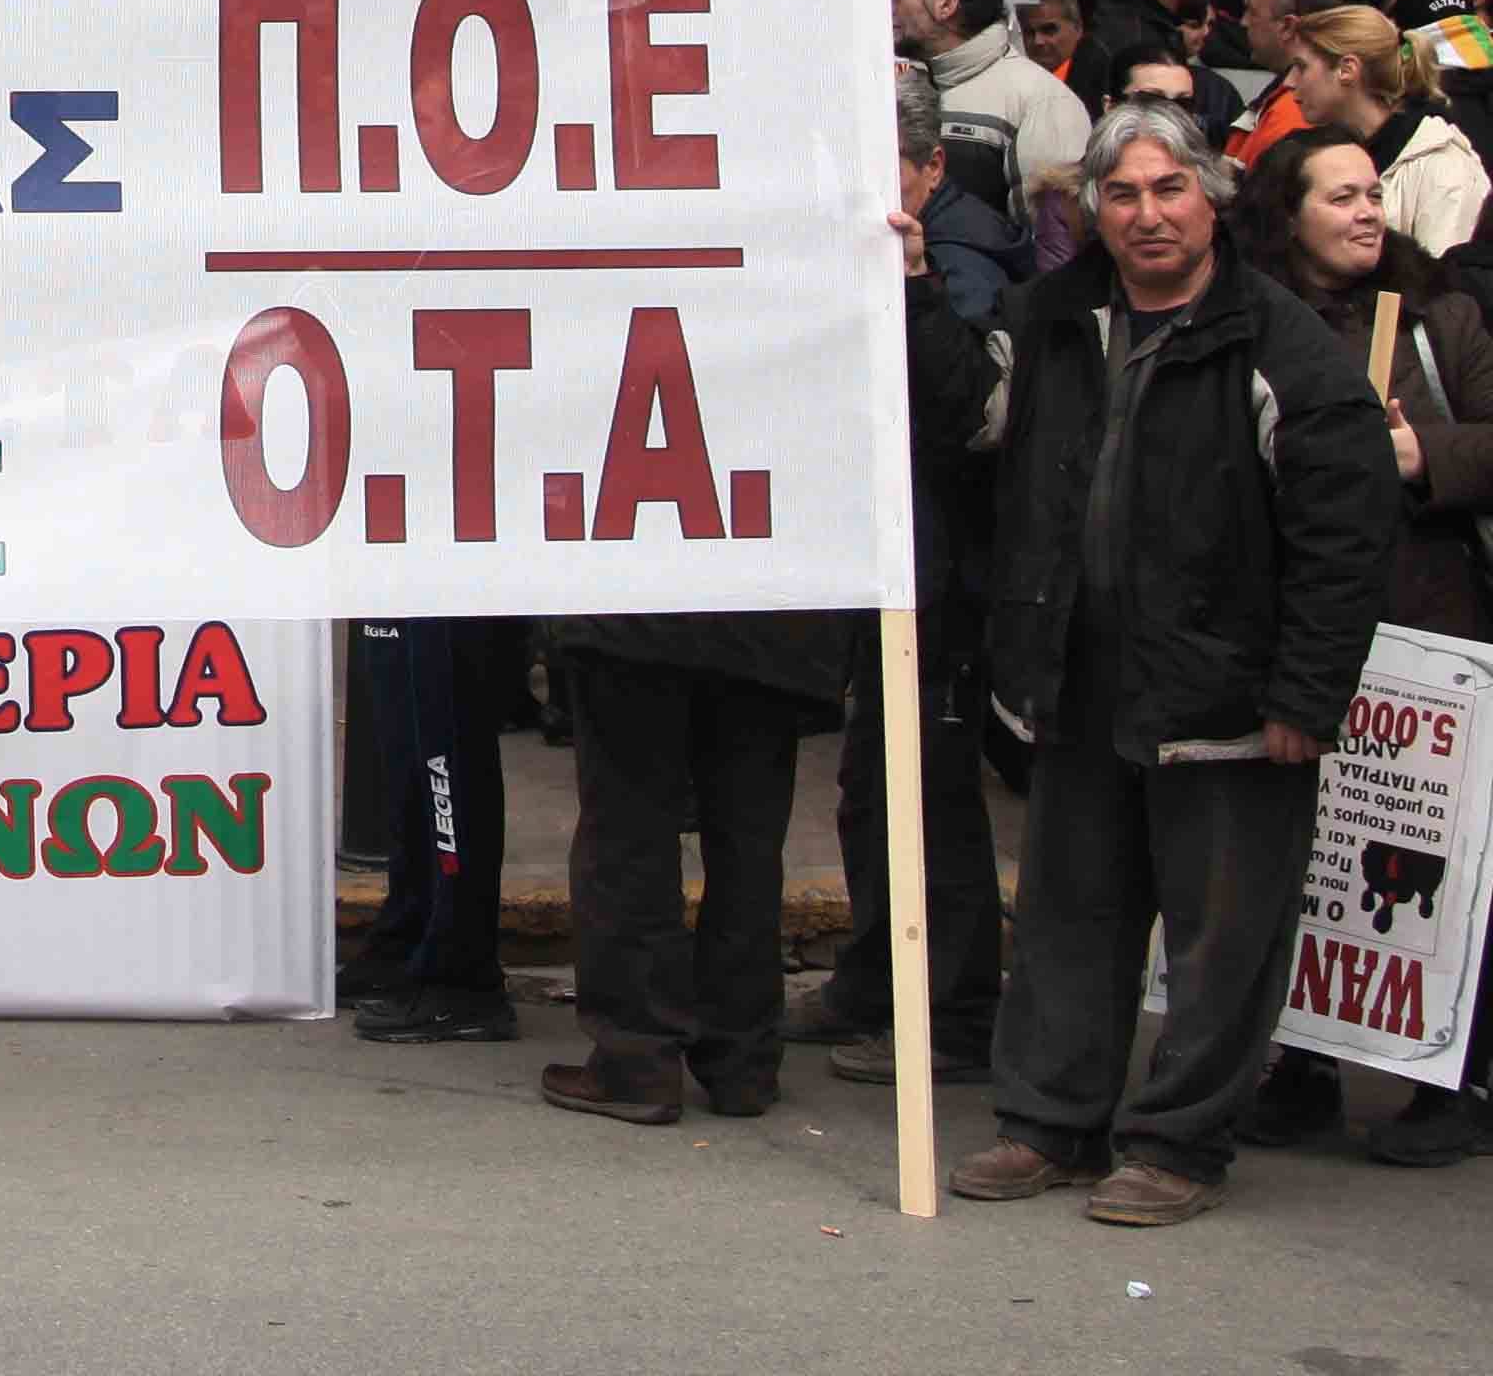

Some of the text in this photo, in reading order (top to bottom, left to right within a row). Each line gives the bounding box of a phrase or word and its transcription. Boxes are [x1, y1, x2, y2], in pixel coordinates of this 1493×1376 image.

[220, 306, 772, 548] Ο.Τ.Α.
[427, 754, 457, 853] LEGEA
[1289, 933, 1425, 1041] WAN
